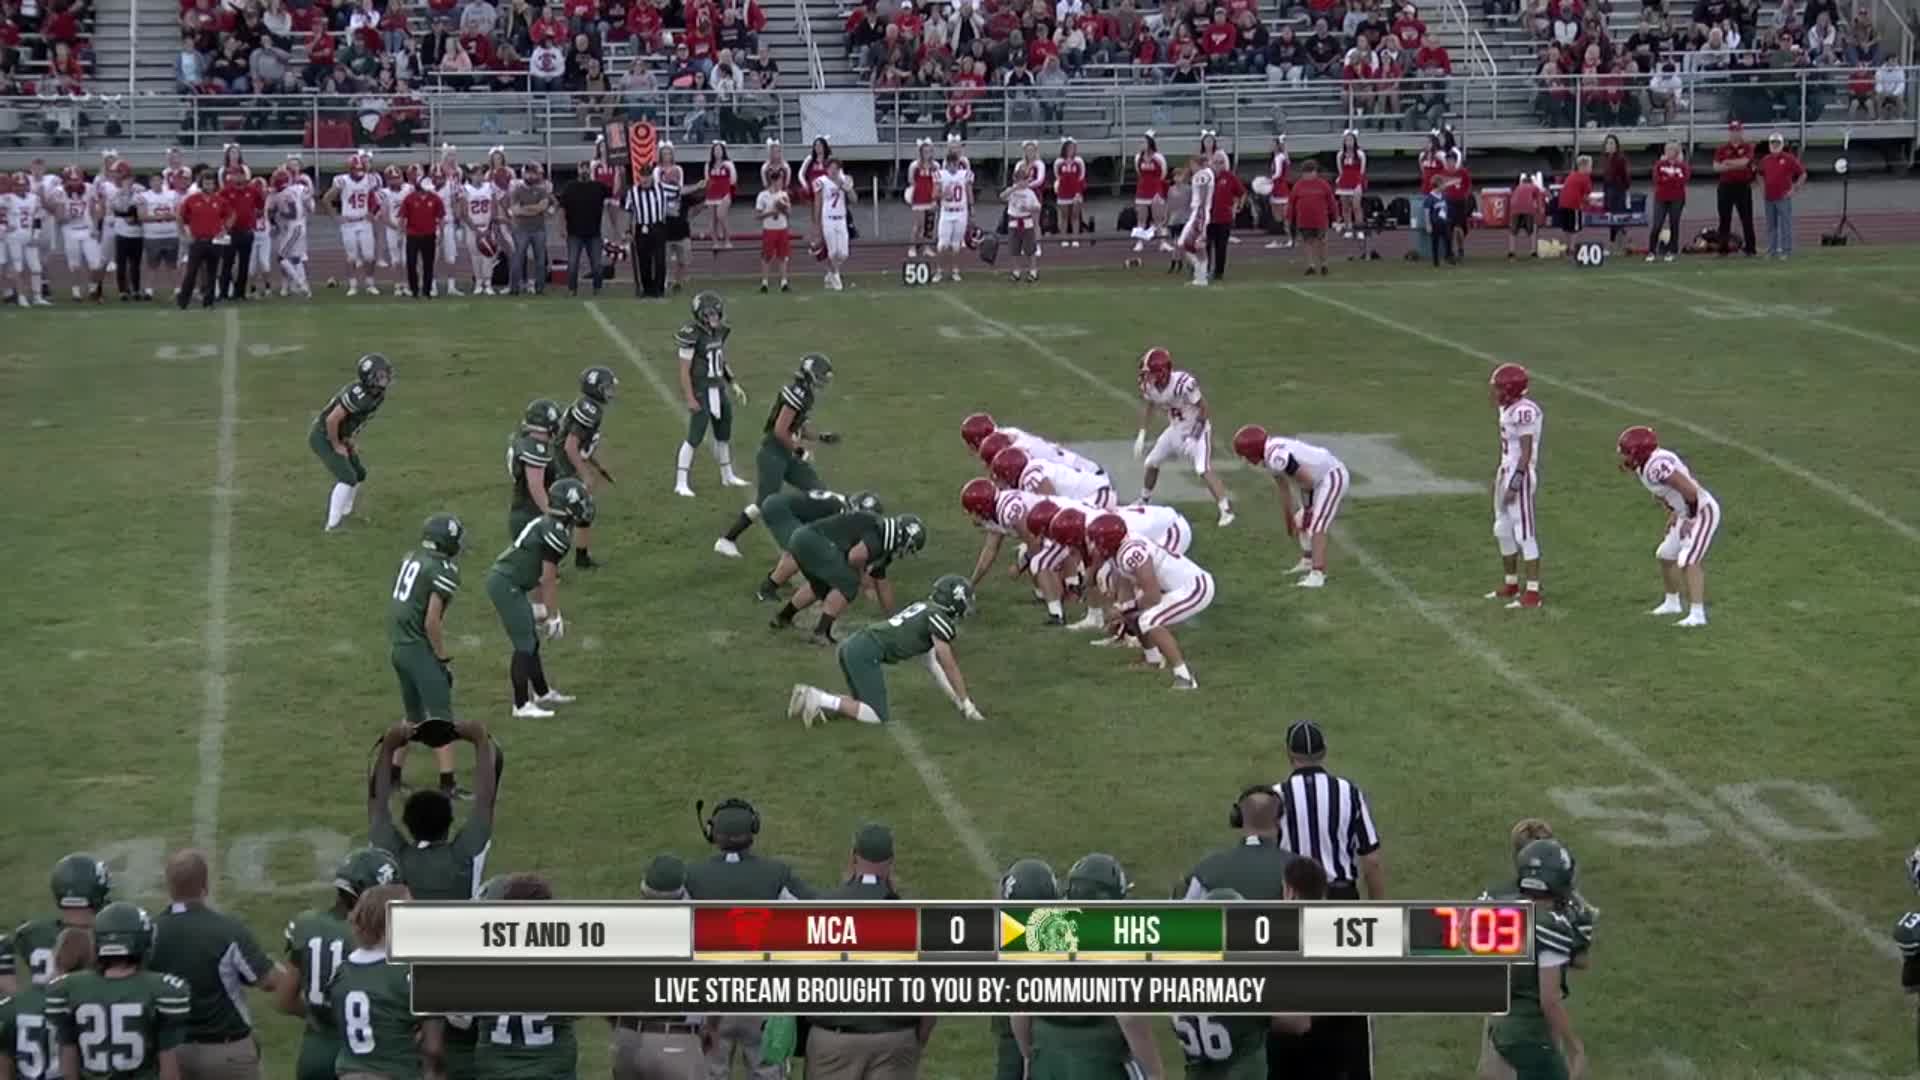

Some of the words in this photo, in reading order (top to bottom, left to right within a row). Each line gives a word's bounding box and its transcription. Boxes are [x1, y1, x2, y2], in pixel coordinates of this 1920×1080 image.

[1576, 244, 1601, 265] 40
[904, 263, 929, 283] 50
[706, 350, 724, 378] 10
[1517, 410, 1532, 425] 16
[1651, 463, 1672, 481] 24
[1126, 550, 1145, 568] 88
[393, 559, 421, 602] 19
[345, 990, 376, 1054] 8
[75, 1003, 145, 1072] 25
